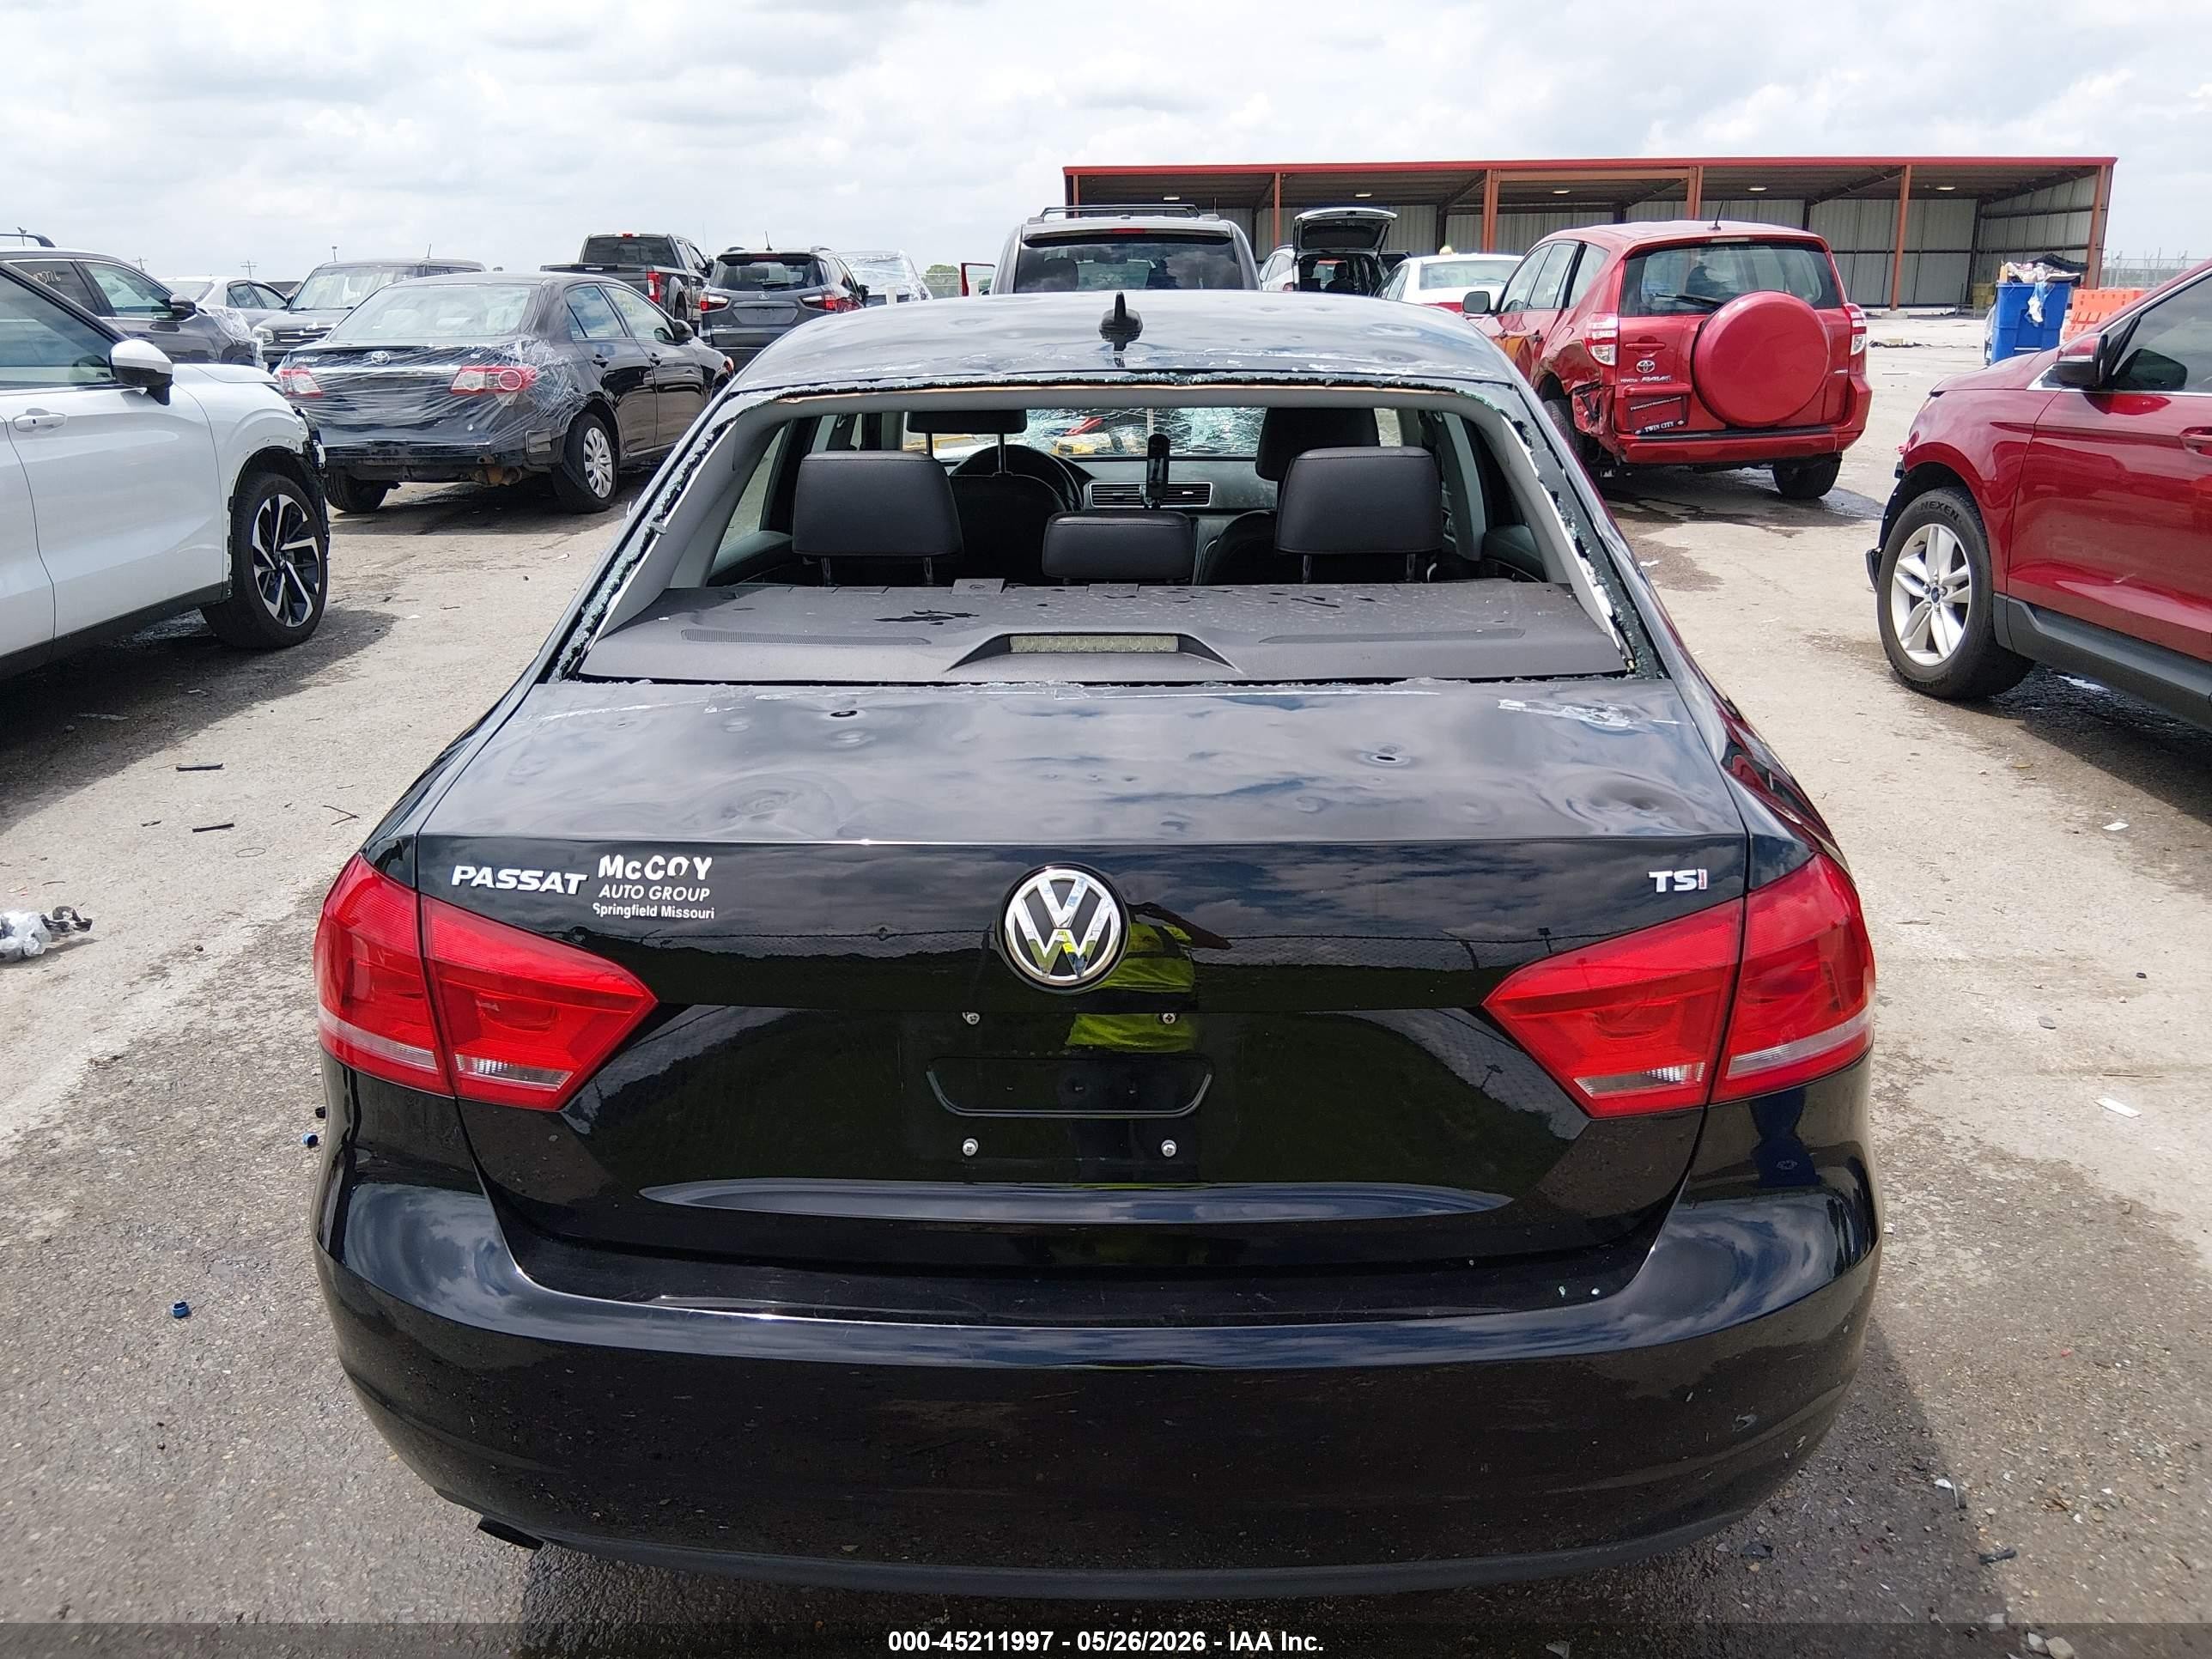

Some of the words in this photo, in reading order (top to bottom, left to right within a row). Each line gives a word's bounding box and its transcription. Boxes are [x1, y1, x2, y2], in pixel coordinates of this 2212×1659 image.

[1661, 421, 1674, 429] CITY
[1920, 501, 1960, 521] NEXEN
[451, 865, 588, 896] PASSAT
[1648, 868, 1708, 893] TSI
[598, 883, 645, 900] AUTO
[648, 884, 711, 902] GROUP
[592, 902, 658, 919] Springfield
[660, 904, 715, 920] Missouri
